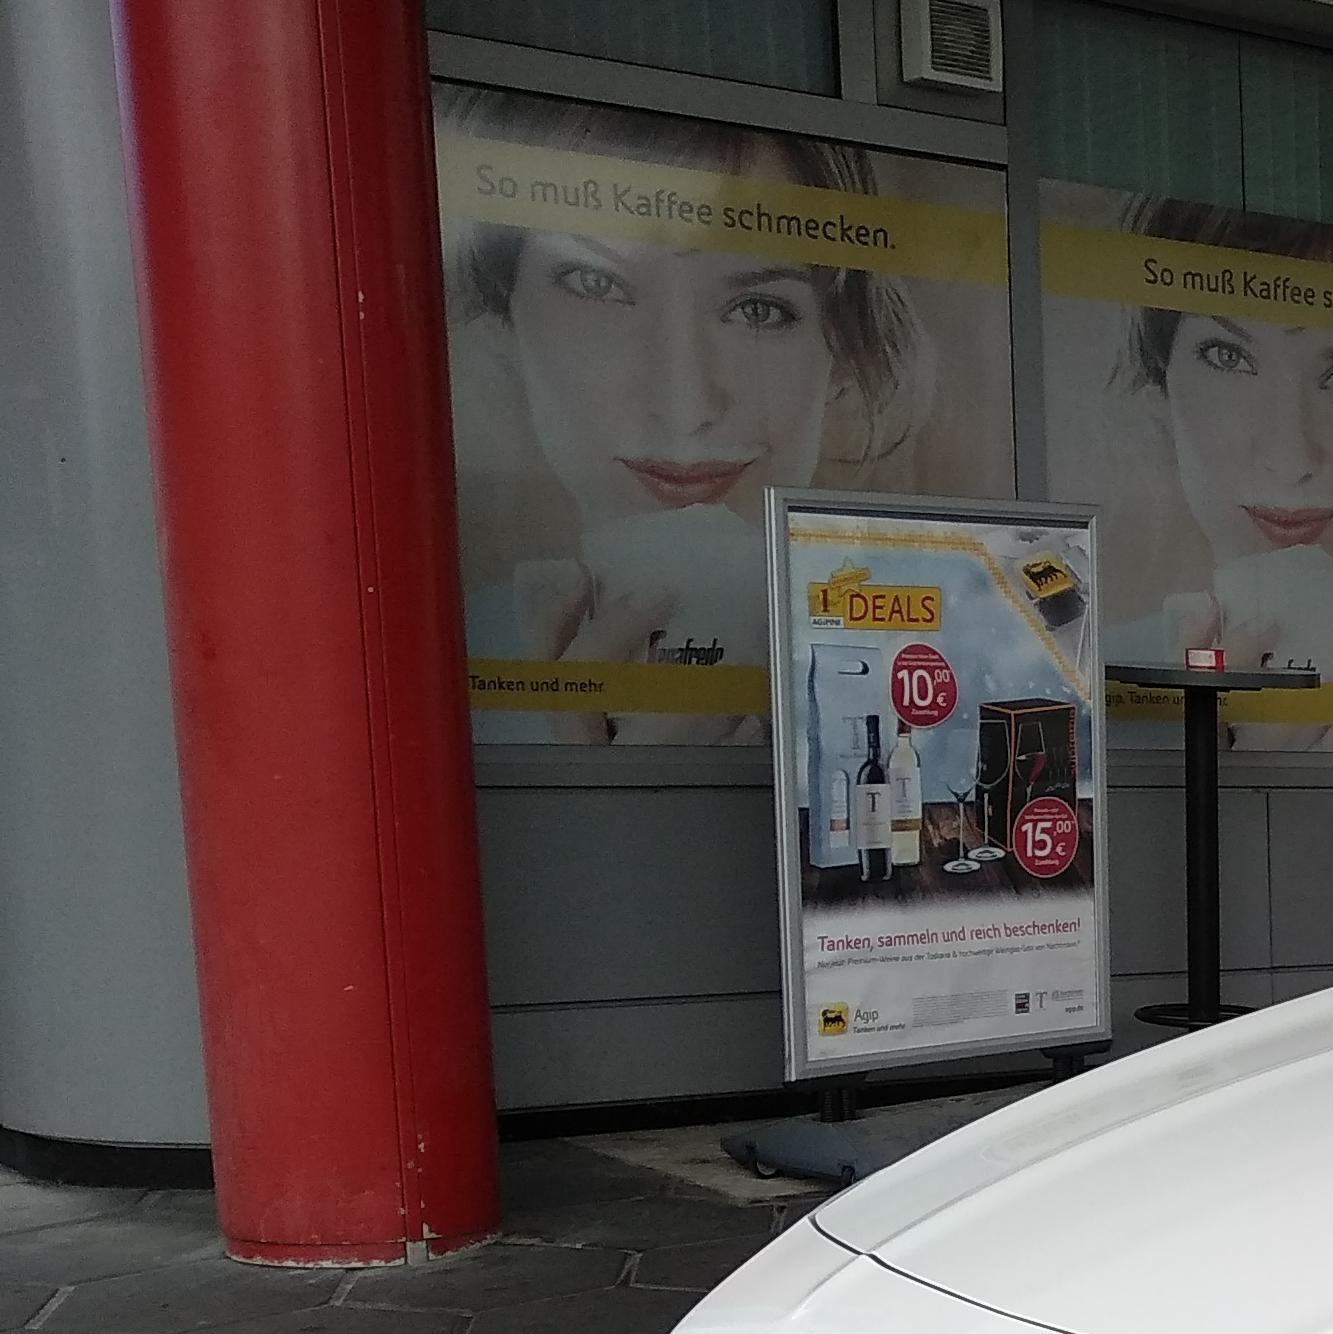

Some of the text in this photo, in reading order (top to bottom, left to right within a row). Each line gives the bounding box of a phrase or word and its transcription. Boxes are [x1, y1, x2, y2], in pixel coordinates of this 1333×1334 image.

[476, 164, 896, 250] So muß Kaffee schmecken.
[1144, 258, 1174, 287] So
[1183, 269, 1235, 295] muß
[1243, 271, 1315, 306] Kaffee
[850, 593, 935, 623] DEALS
[468, 675, 525, 692] Tanken
[531, 677, 559, 692] und
[1128, 690, 1170, 704] Tanken
[818, 918, 1081, 952] Tanken, sammeln und reich beschenken!
[854, 1009, 879, 1024] Agip
